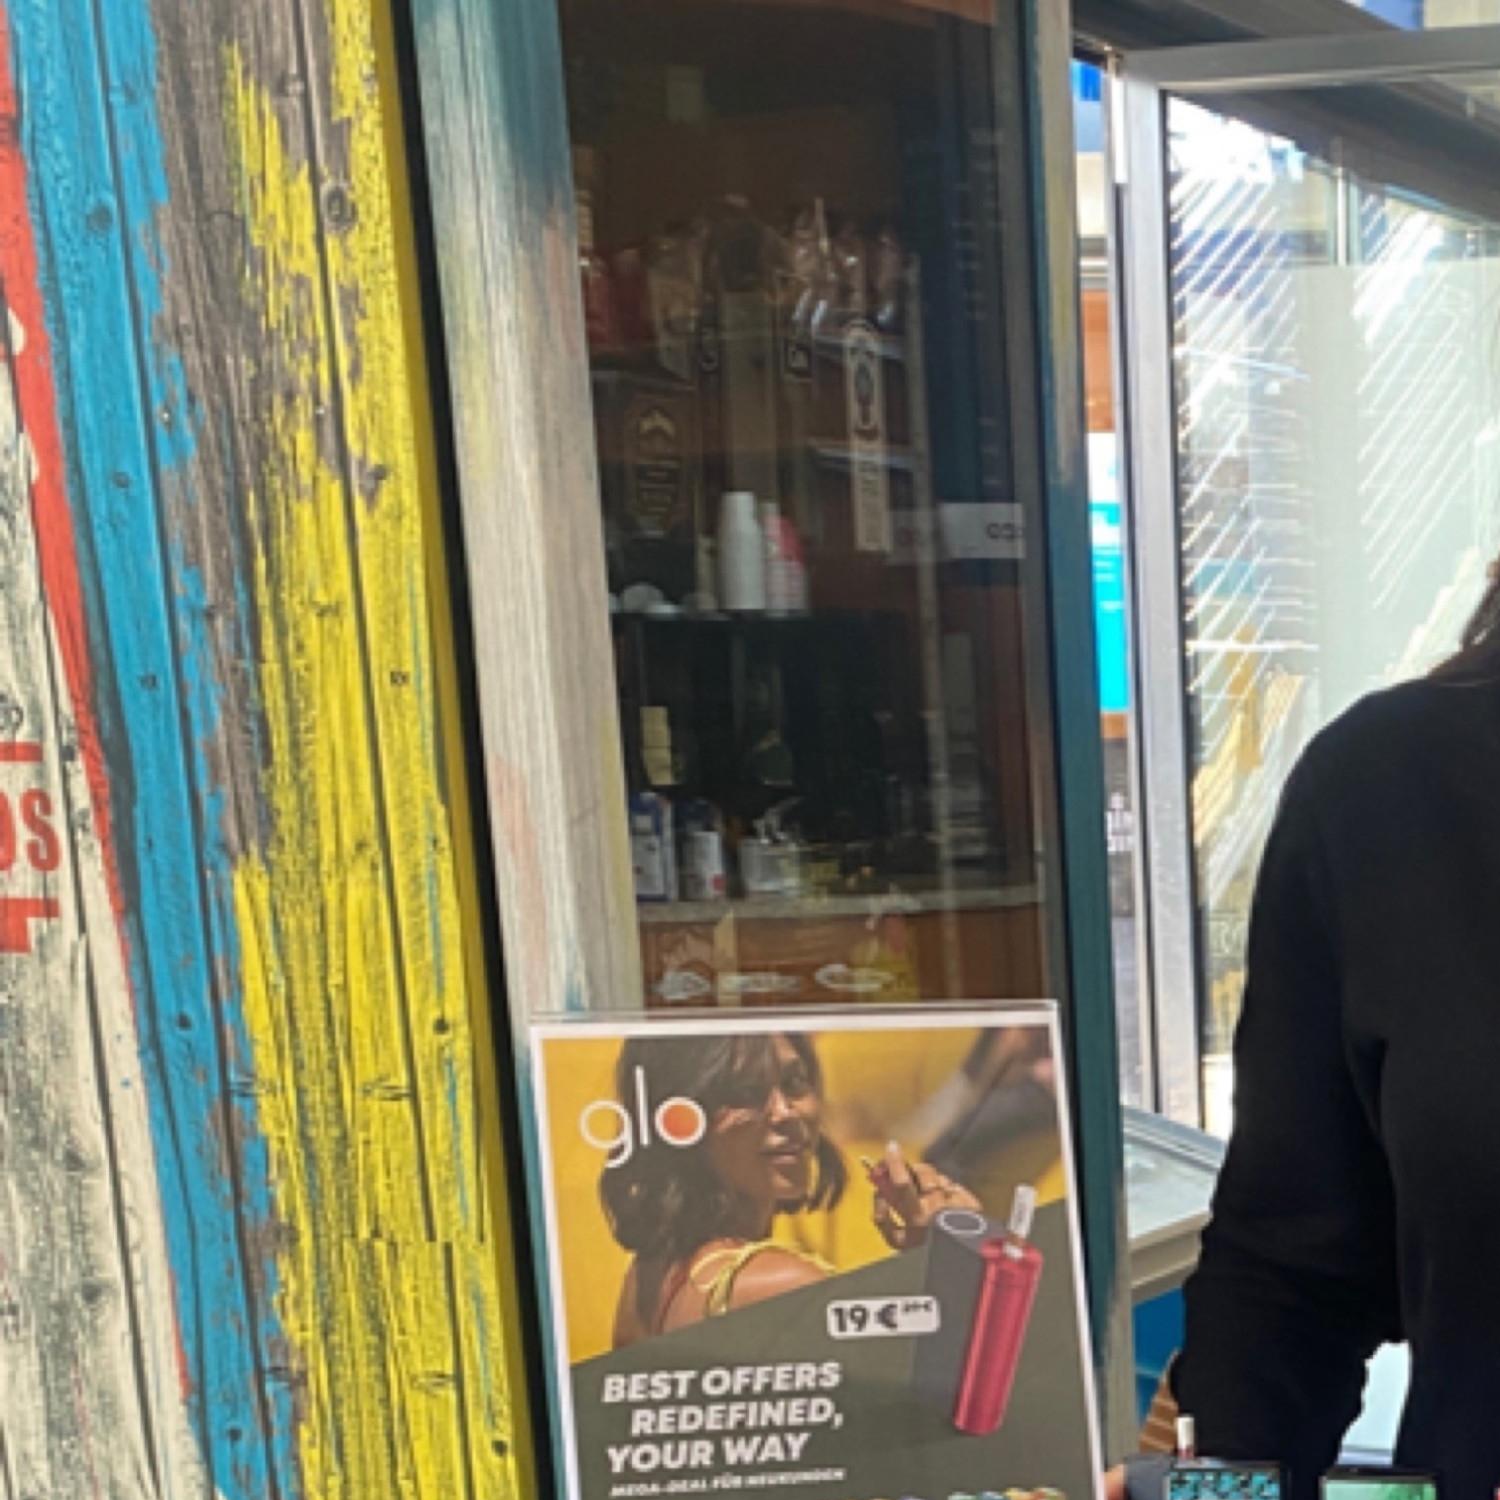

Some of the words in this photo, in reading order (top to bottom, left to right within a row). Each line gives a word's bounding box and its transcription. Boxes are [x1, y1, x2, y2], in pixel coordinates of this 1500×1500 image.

[580, 1064, 706, 1168] glo
[832, 1305, 868, 1333] 19
[875, 1303, 899, 1330] €
[603, 1370, 698, 1403] BEST
[701, 1361, 843, 1396] OFFERS
[630, 1397, 844, 1437] REDEFINED,
[607, 1439, 715, 1473] YOUR
[721, 1432, 812, 1465] WAY
